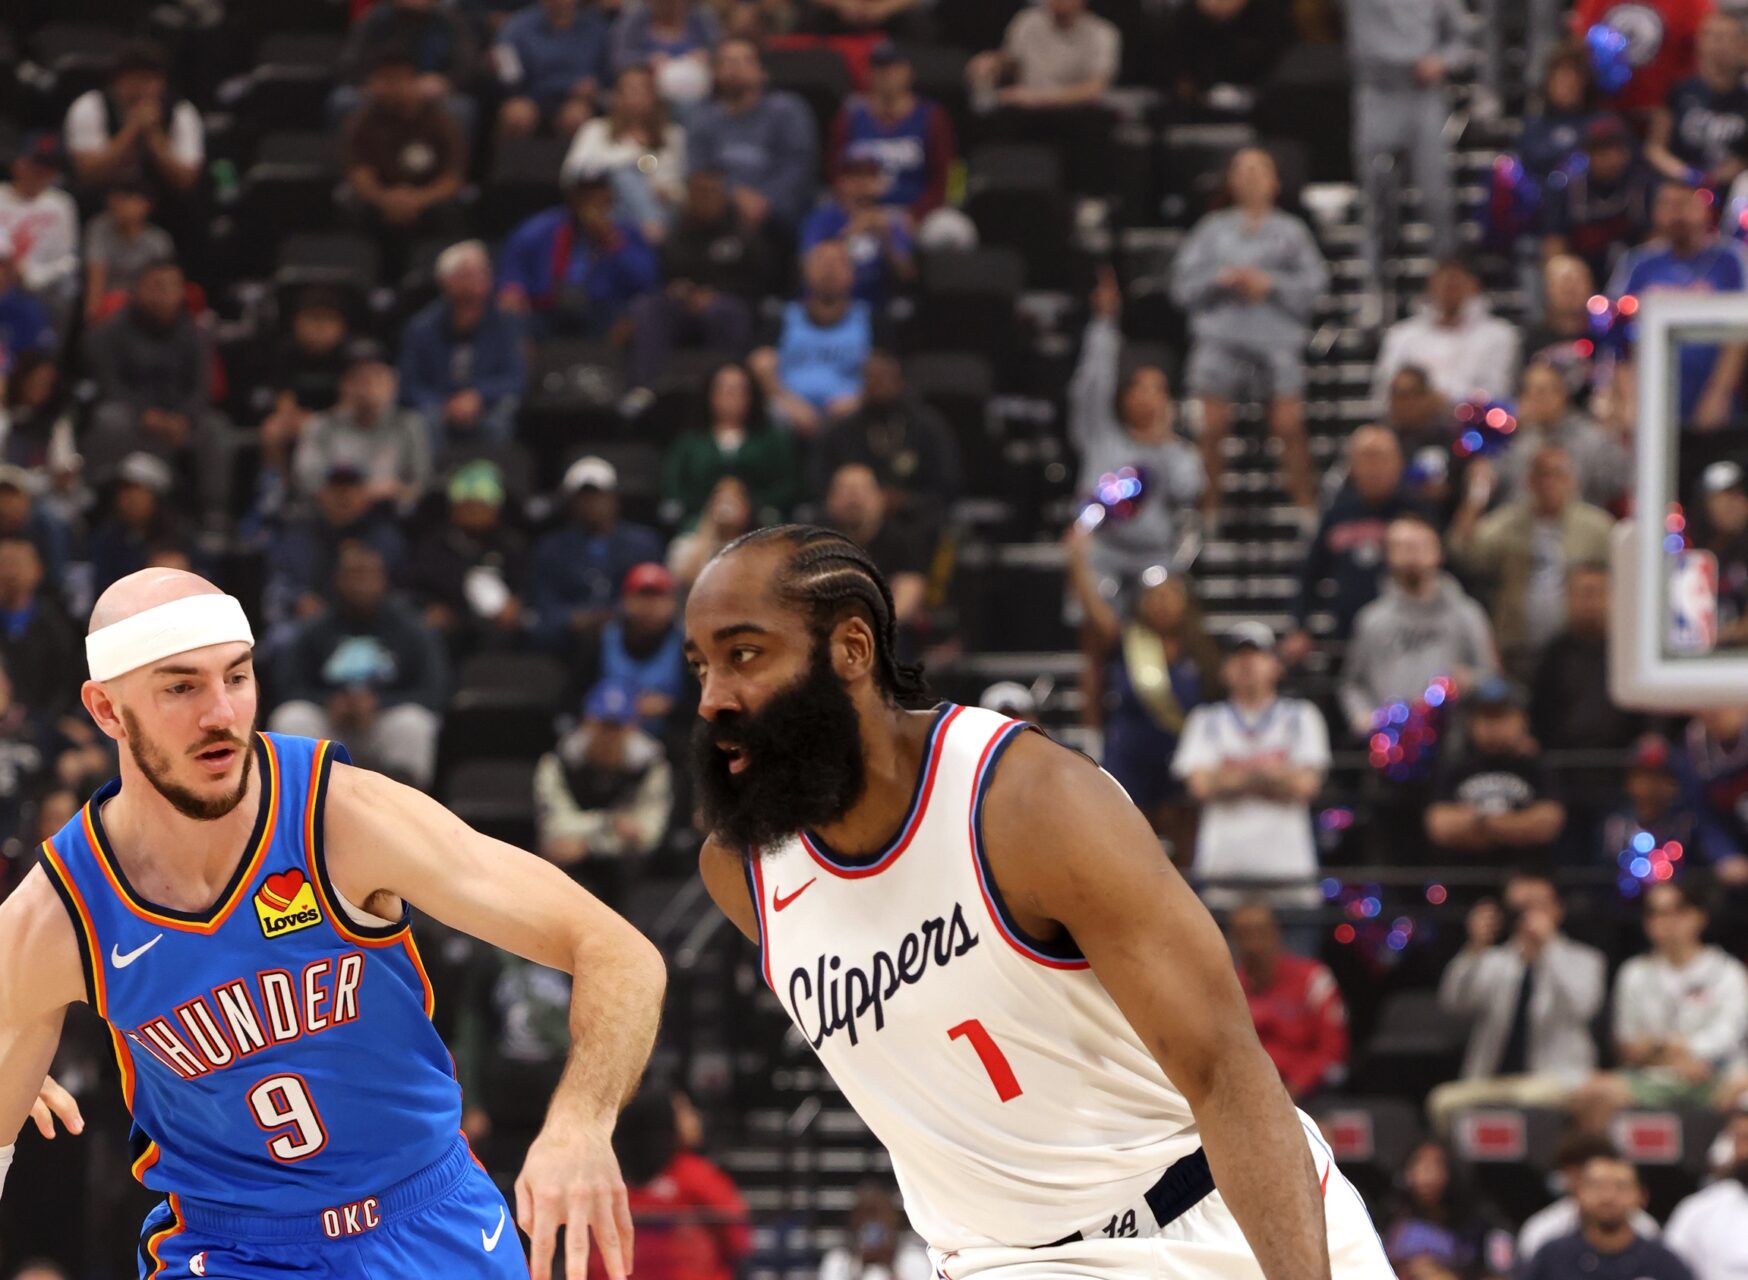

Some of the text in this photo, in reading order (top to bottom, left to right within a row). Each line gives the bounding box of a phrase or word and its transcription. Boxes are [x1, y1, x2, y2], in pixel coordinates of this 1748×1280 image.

[789, 901, 979, 1050] Clippers
[946, 1018, 1024, 1103] 1
[246, 1073, 328, 1163] 9
[321, 1197, 381, 1239] OKC
